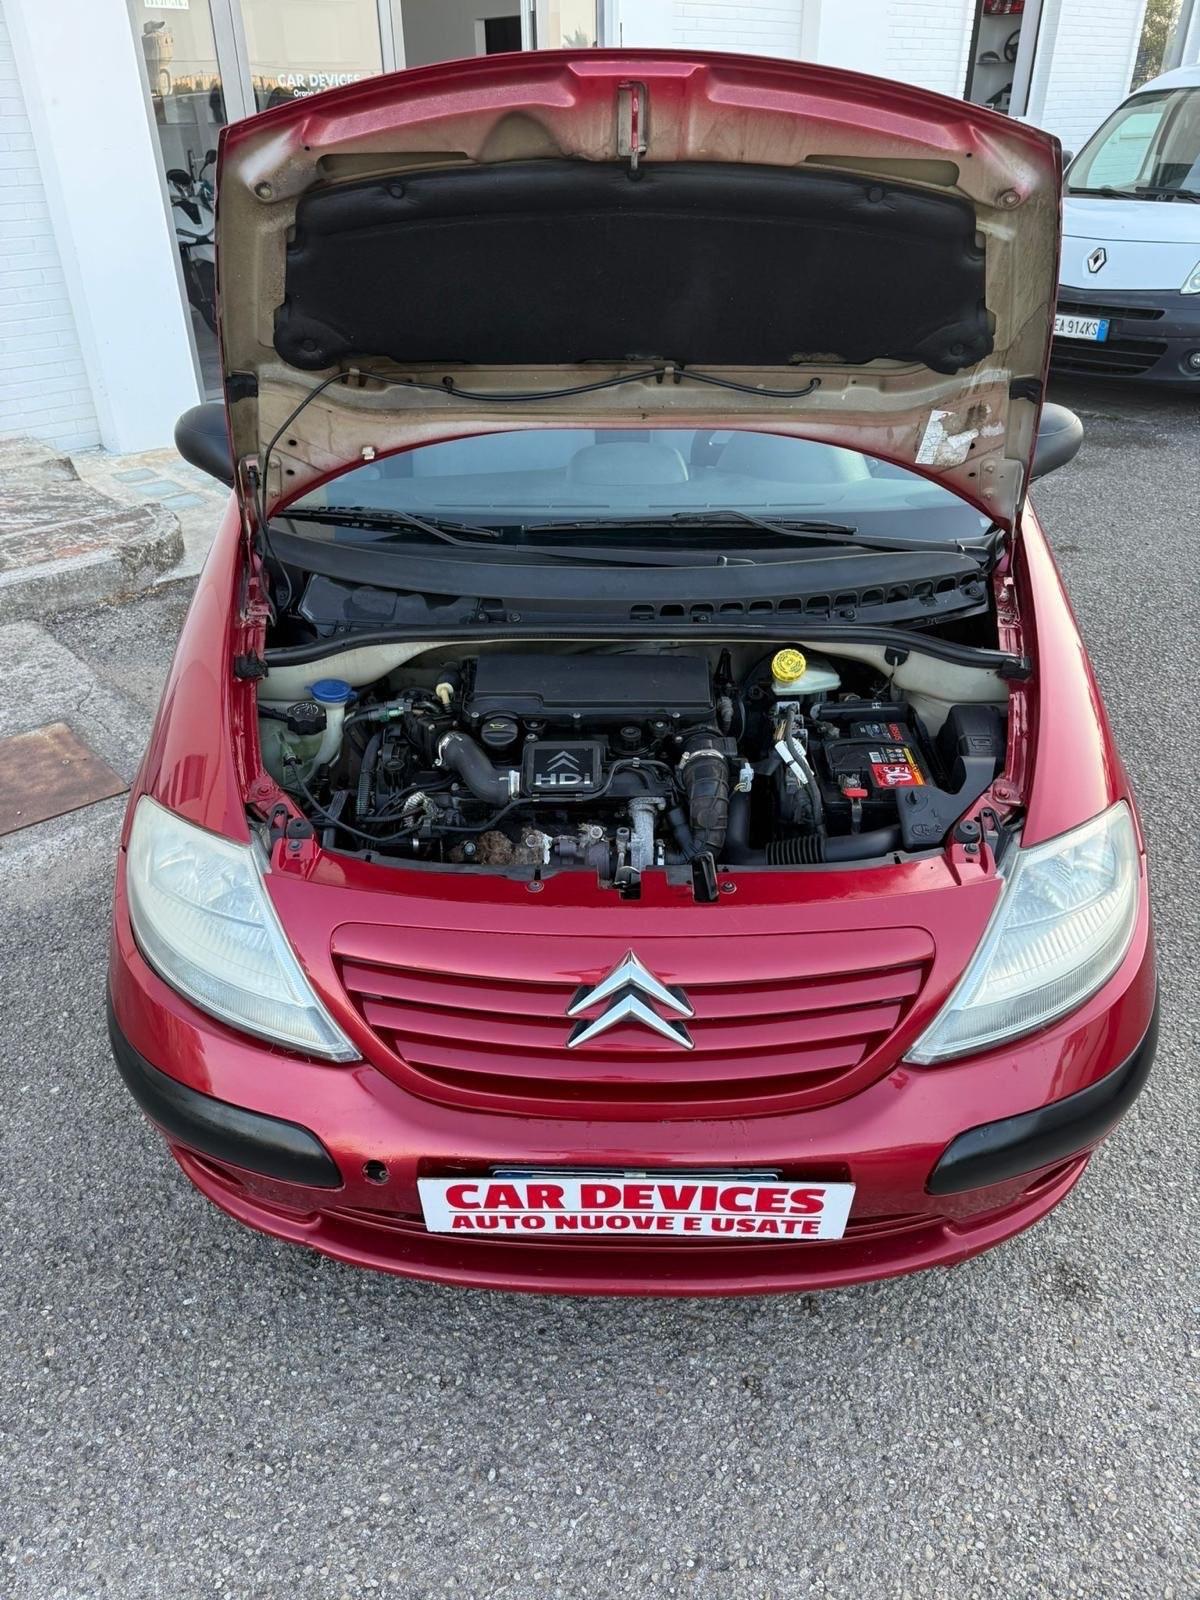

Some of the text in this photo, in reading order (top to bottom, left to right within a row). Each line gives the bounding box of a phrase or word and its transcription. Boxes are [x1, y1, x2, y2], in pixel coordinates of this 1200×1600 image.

[278, 73, 305, 87] CAR
[1067, 320, 1098, 336] 914KS
[446, 1184, 826, 1214] CAR DEVICES
[452, 1215, 821, 1234] AUTO NUOVE E USATE
